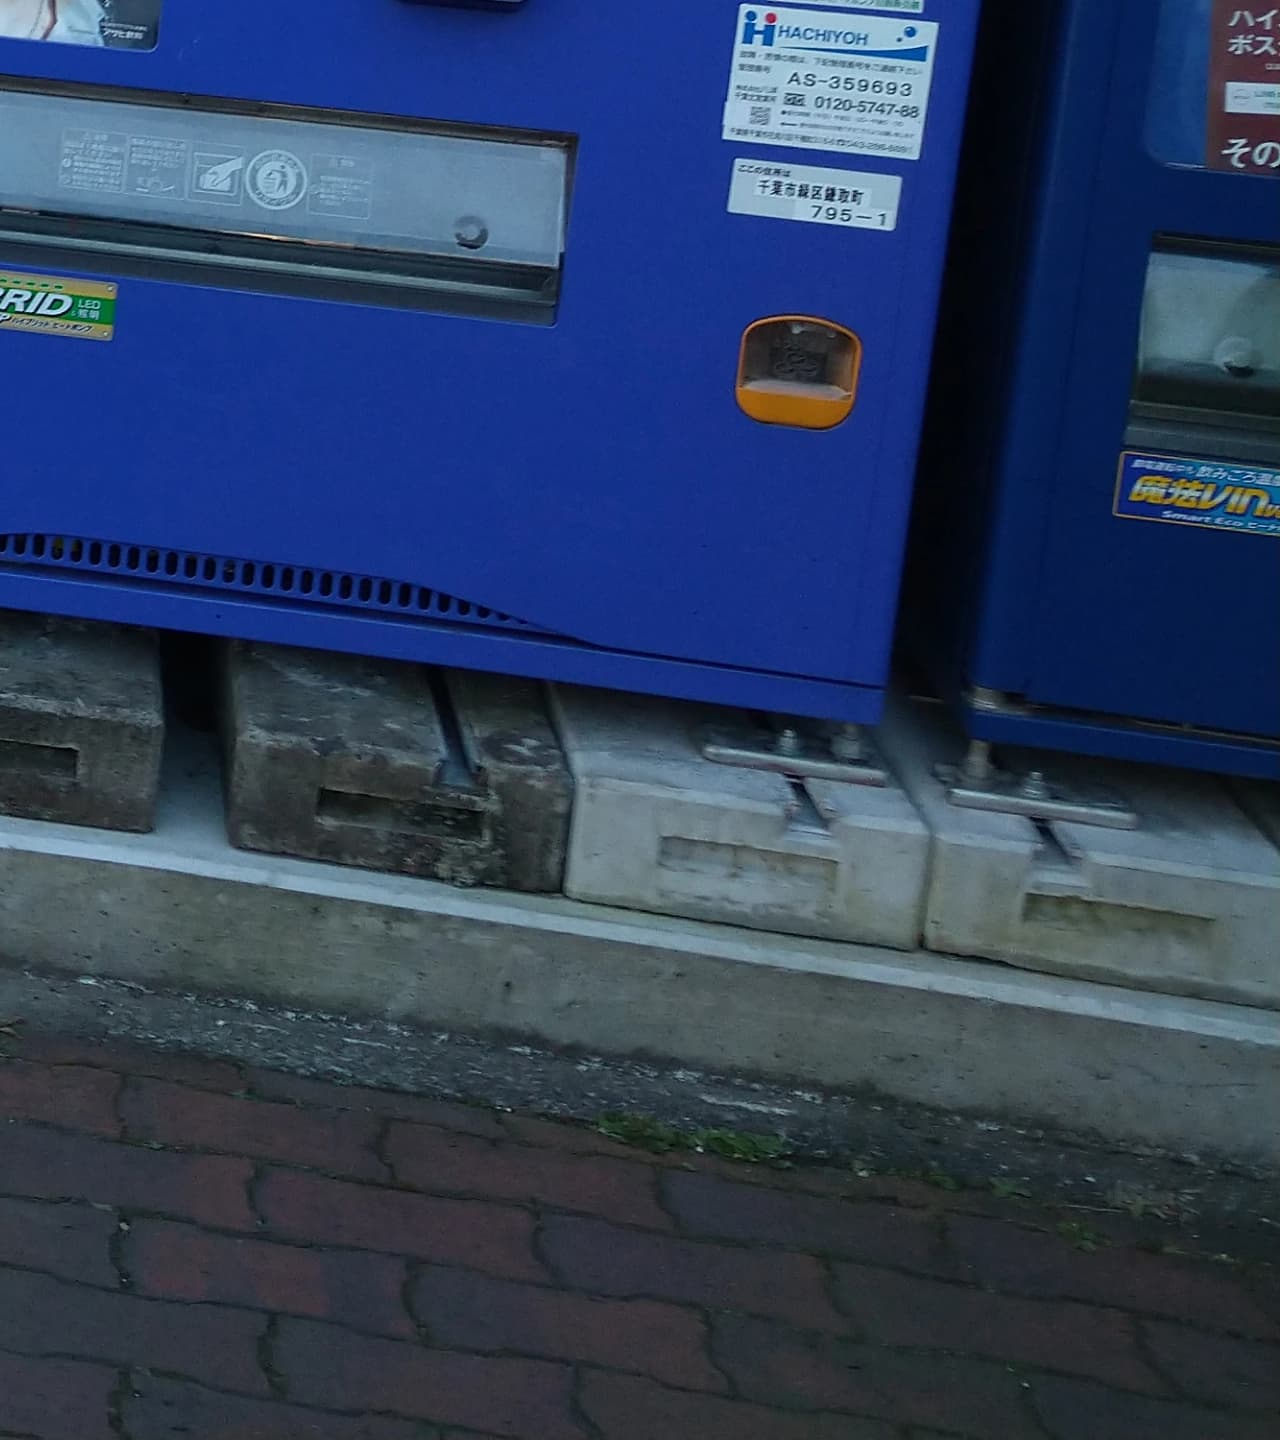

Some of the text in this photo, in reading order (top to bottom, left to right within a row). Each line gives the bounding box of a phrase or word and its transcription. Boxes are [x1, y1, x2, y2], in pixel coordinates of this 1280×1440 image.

[777, 24, 869, 47] HACHIYOH
[787, 71, 914, 97] AS-359693
[813, 95, 920, 119] 0120-5747-88
[737, 164, 791, 178] ここの住所は
[757, 179, 865, 206] 千葉市緑区鎌取町
[77, 298, 102, 310] LED
[1161, 509, 1211, 525] Smart
[1214, 517, 1243, 527] Eco
